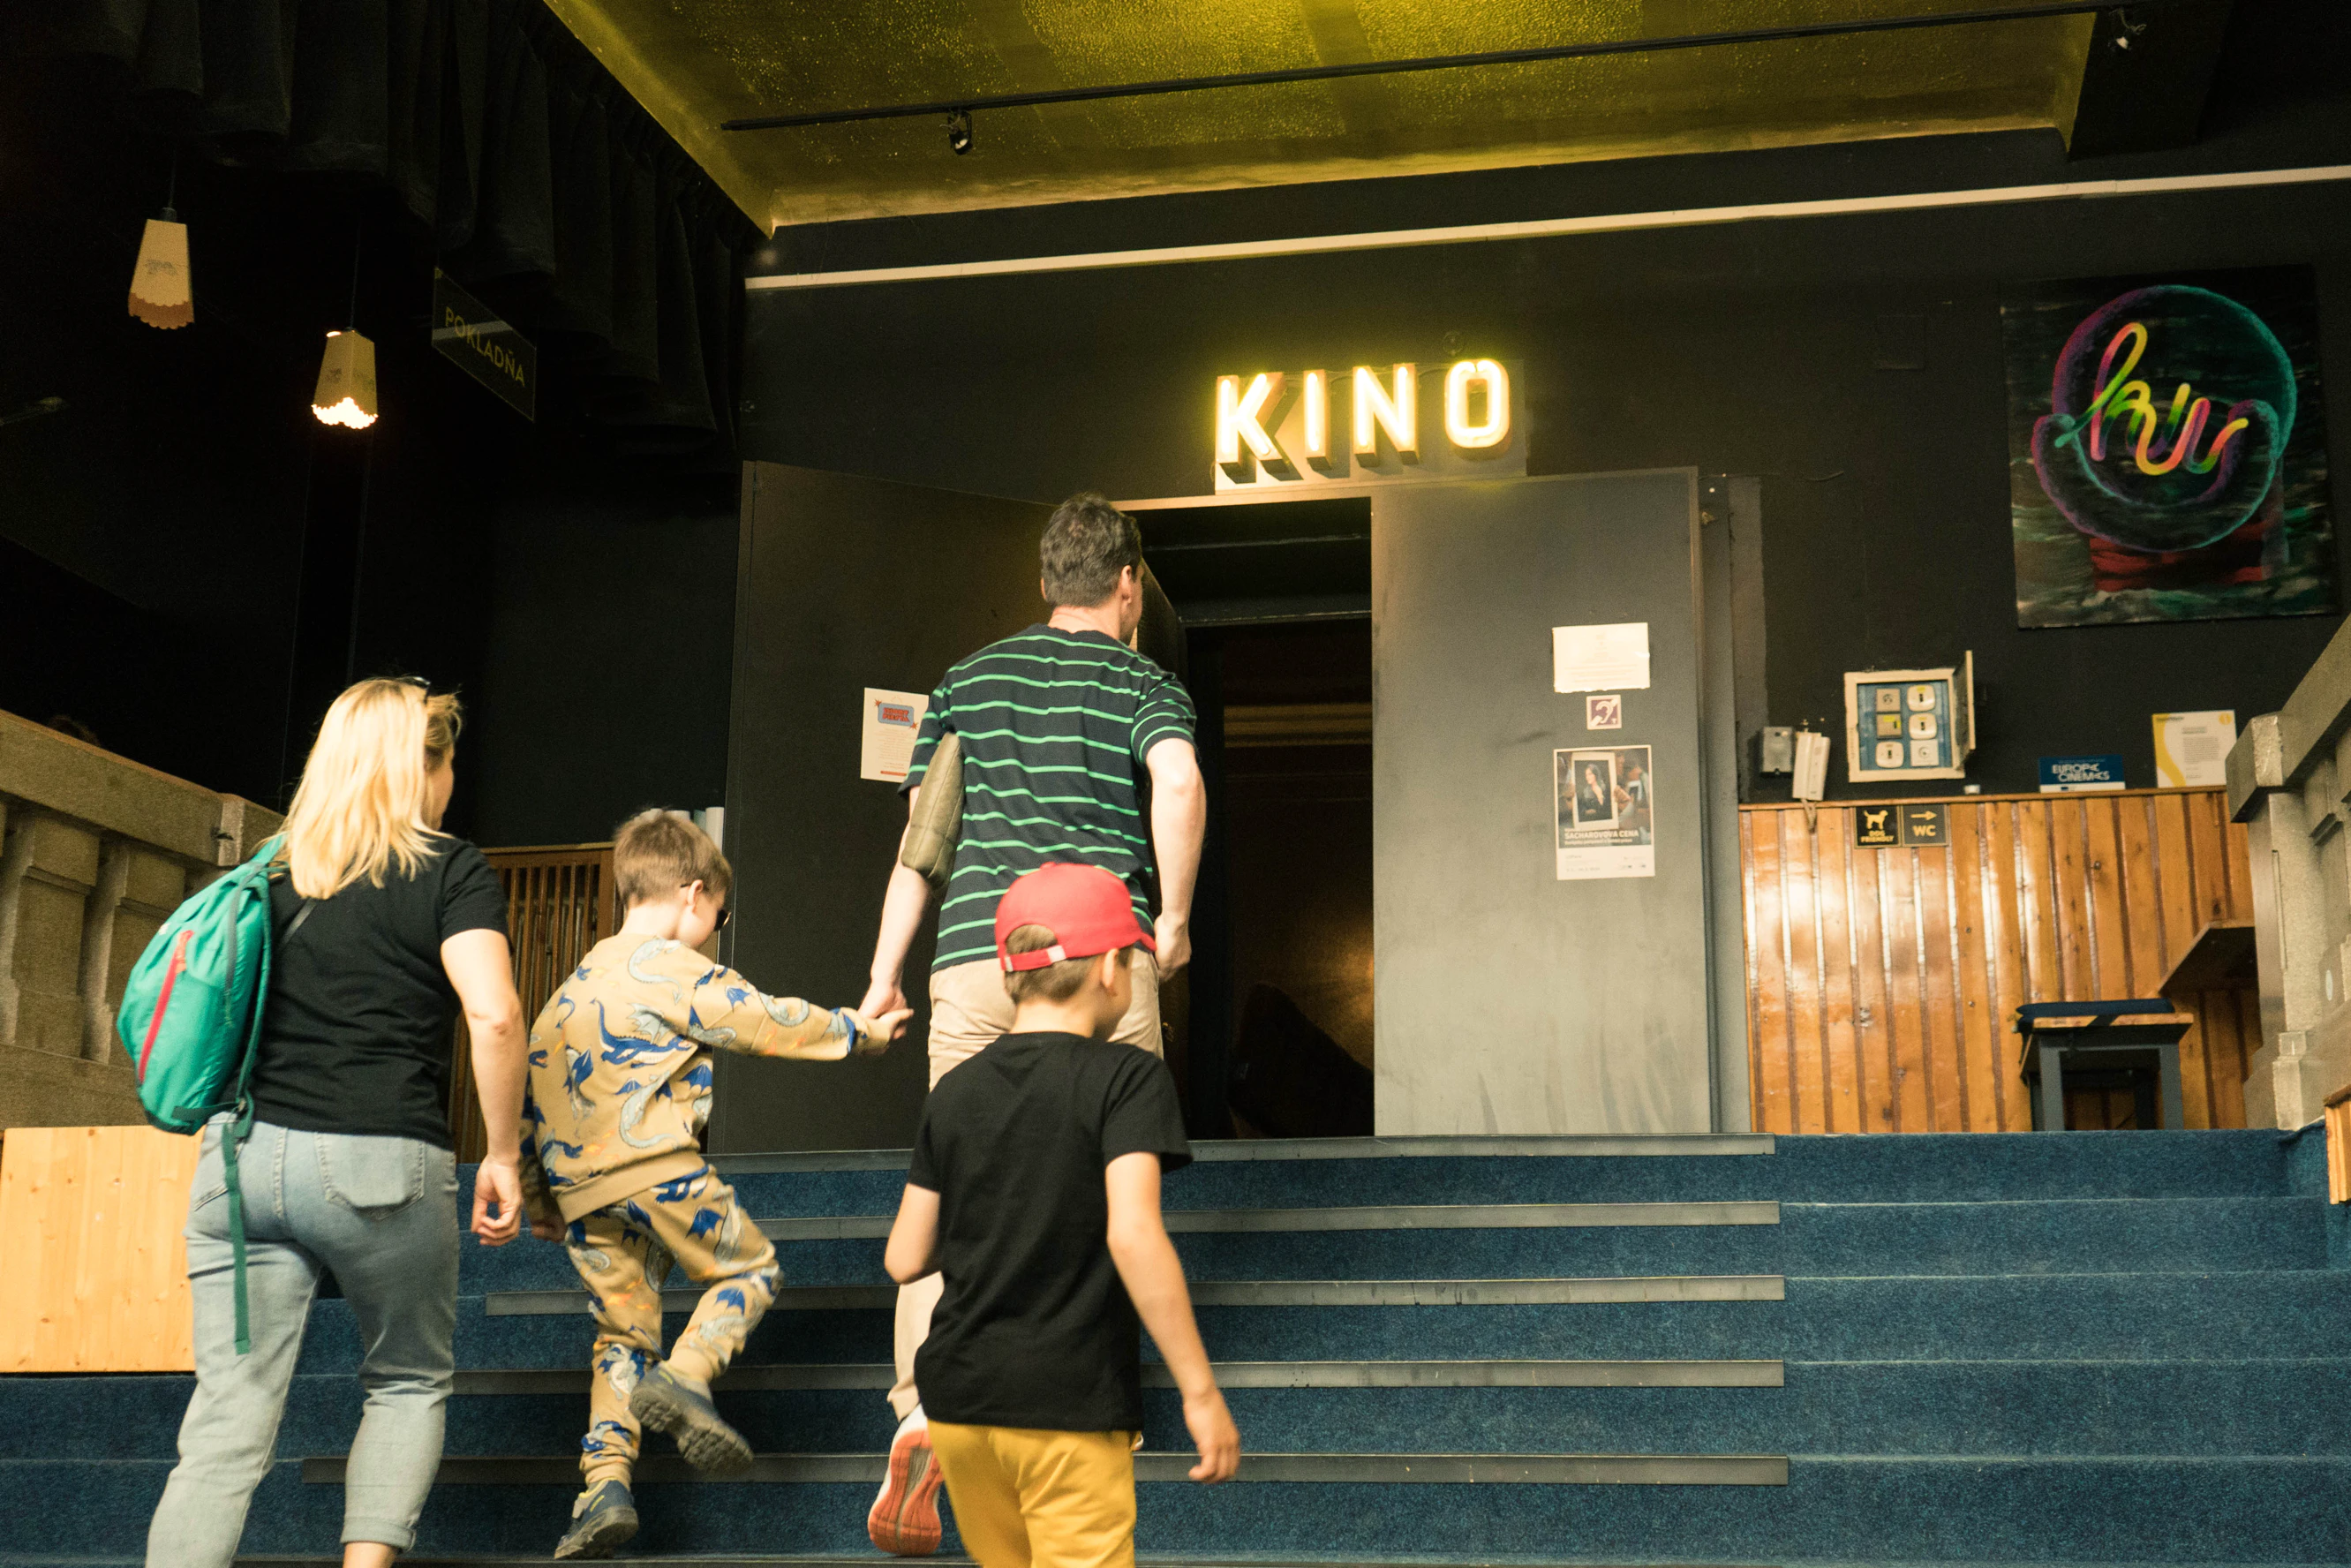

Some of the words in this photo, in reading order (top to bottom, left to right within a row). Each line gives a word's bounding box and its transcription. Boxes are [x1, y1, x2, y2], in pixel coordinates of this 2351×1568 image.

[445, 305, 525, 387] POKLADŇA
[1215, 358, 1511, 464] KINO
[2052, 763, 2099, 774] EUROPA
[2058, 771, 2110, 782] CINEMAS
[1912, 825, 1936, 837] WC
